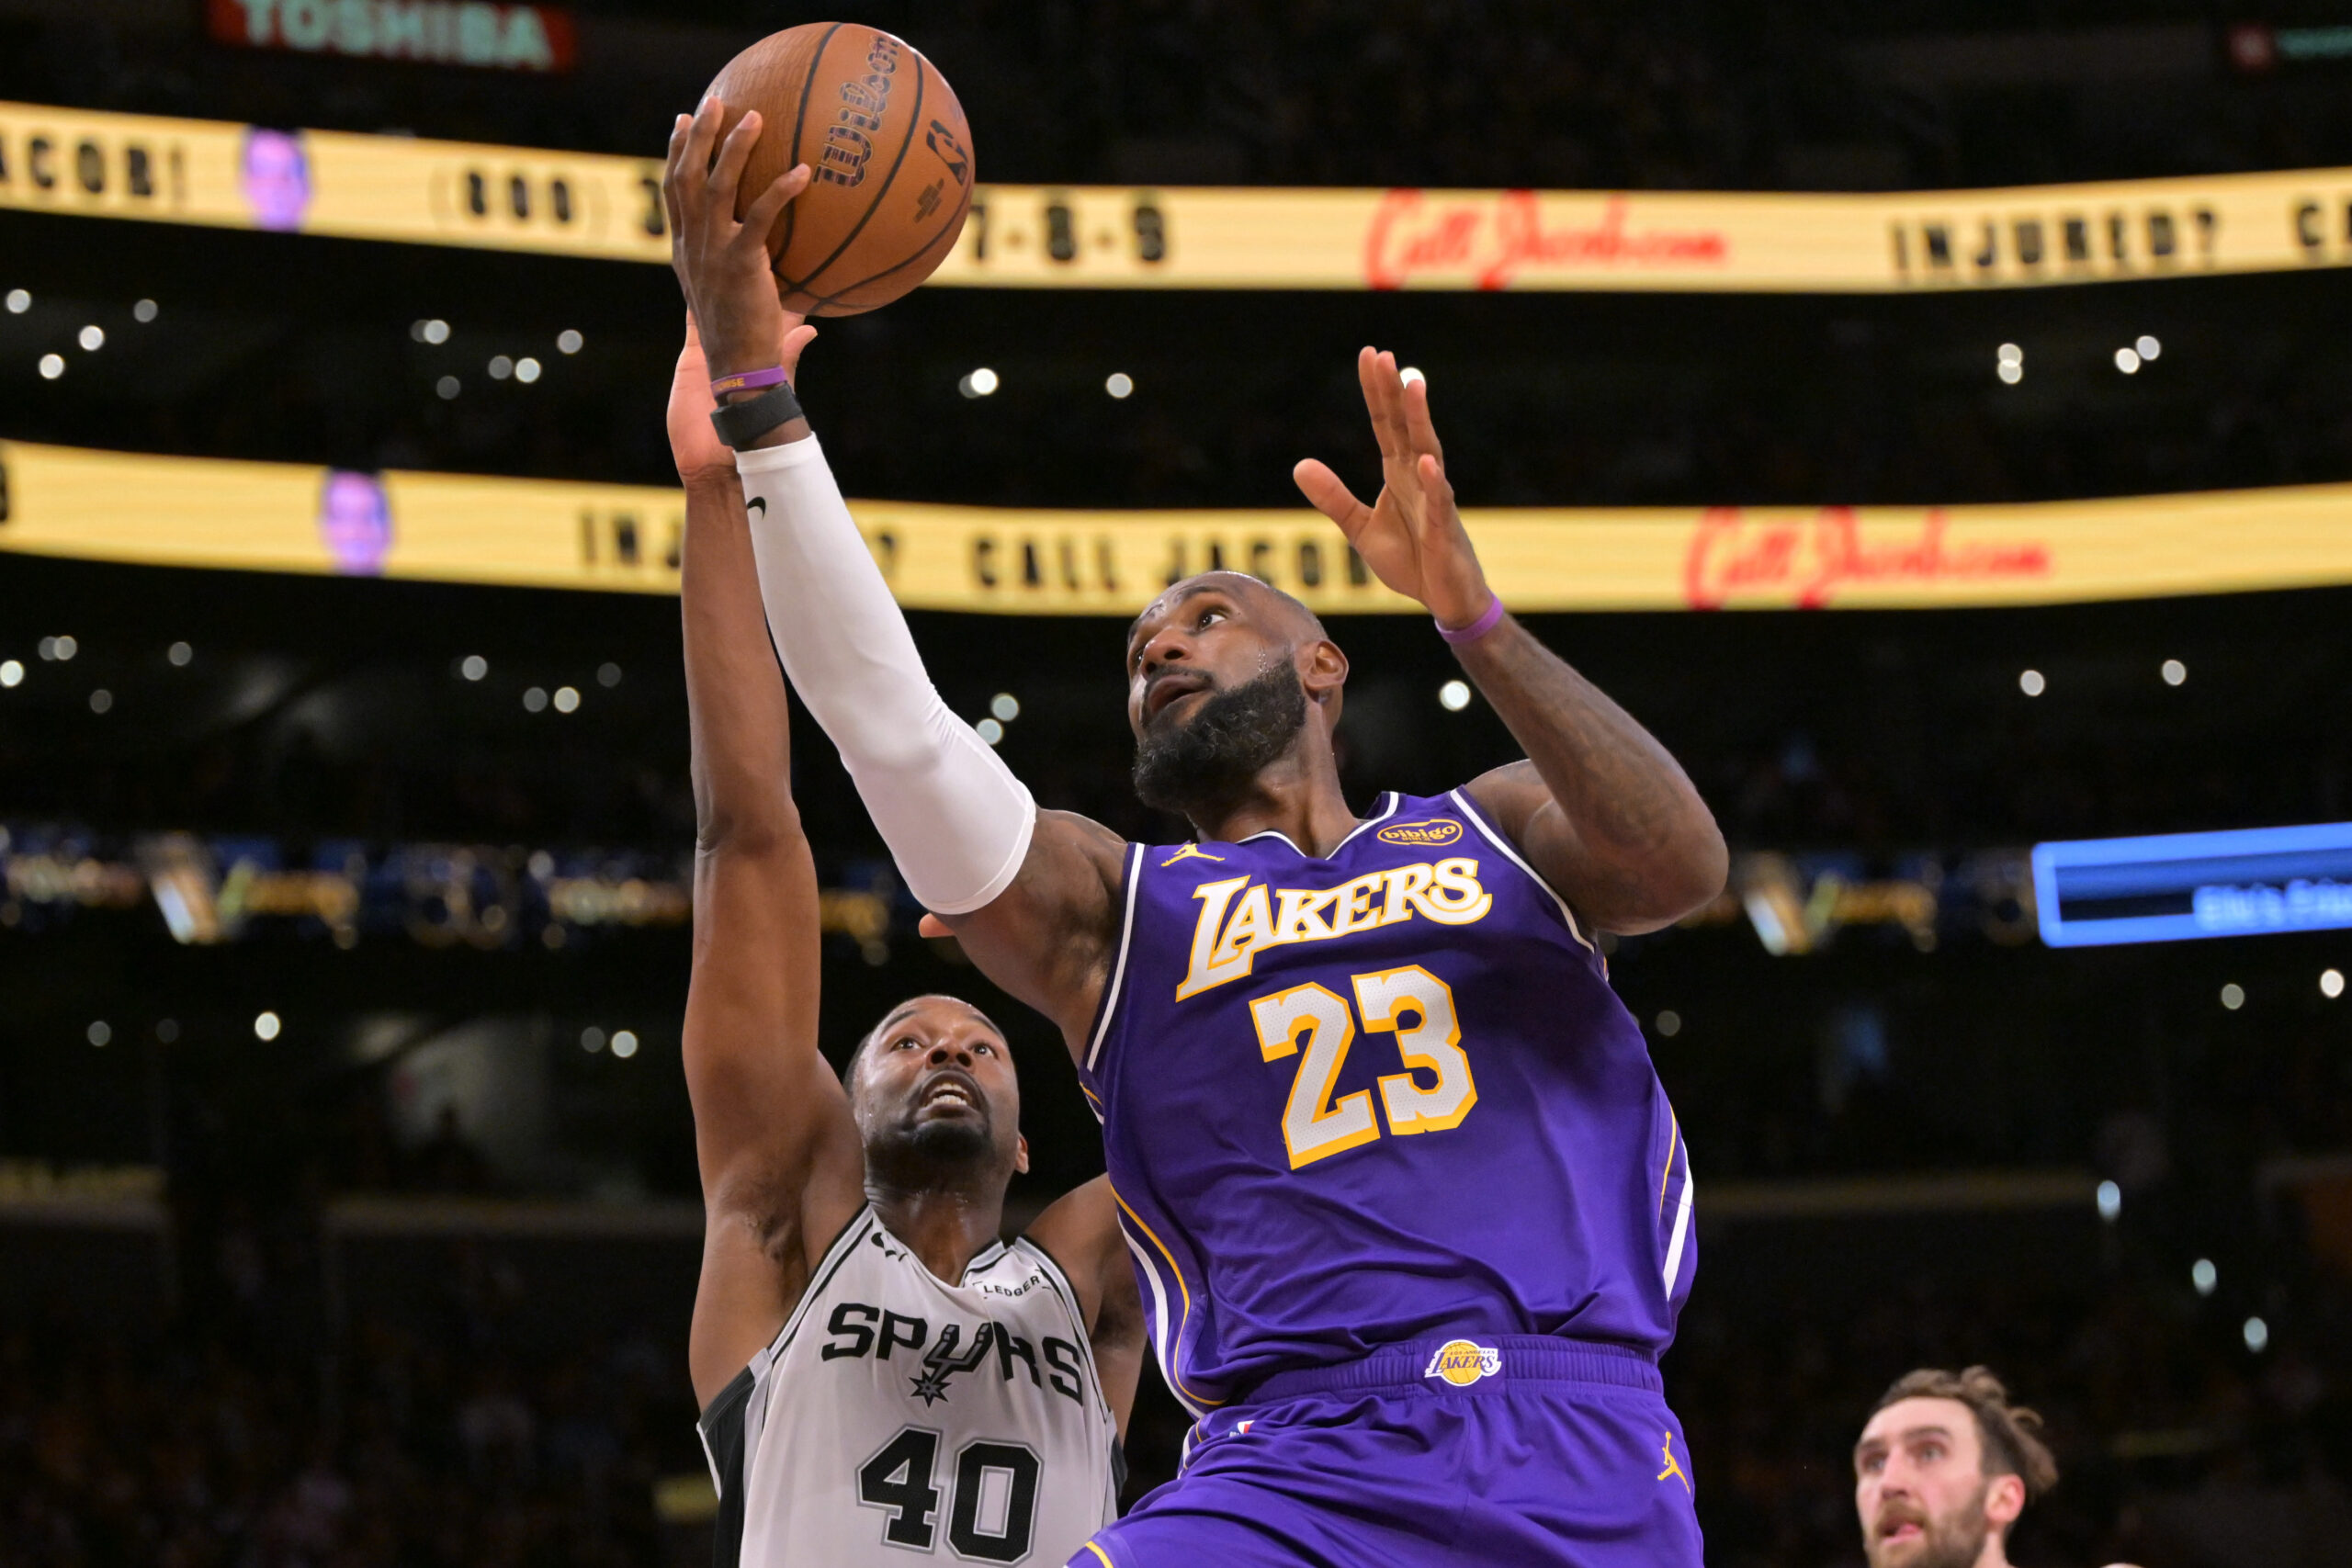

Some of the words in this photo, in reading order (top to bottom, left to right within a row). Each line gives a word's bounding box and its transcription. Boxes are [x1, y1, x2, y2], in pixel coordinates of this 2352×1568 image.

[242, 0, 553, 71] TOSHIBA
[813, 35, 901, 187] Wilson
[974, 537, 1119, 592] CALL
[1384, 825, 1457, 840] bibigo
[1176, 857, 1493, 1003] LAKERS
[1249, 964, 1478, 1169] 23
[983, 1275, 1040, 1297] LEDGER
[821, 1303, 1083, 1408] SPURS
[1429, 1351, 1497, 1374] LAKERS
[854, 1423, 1045, 1568] 40
